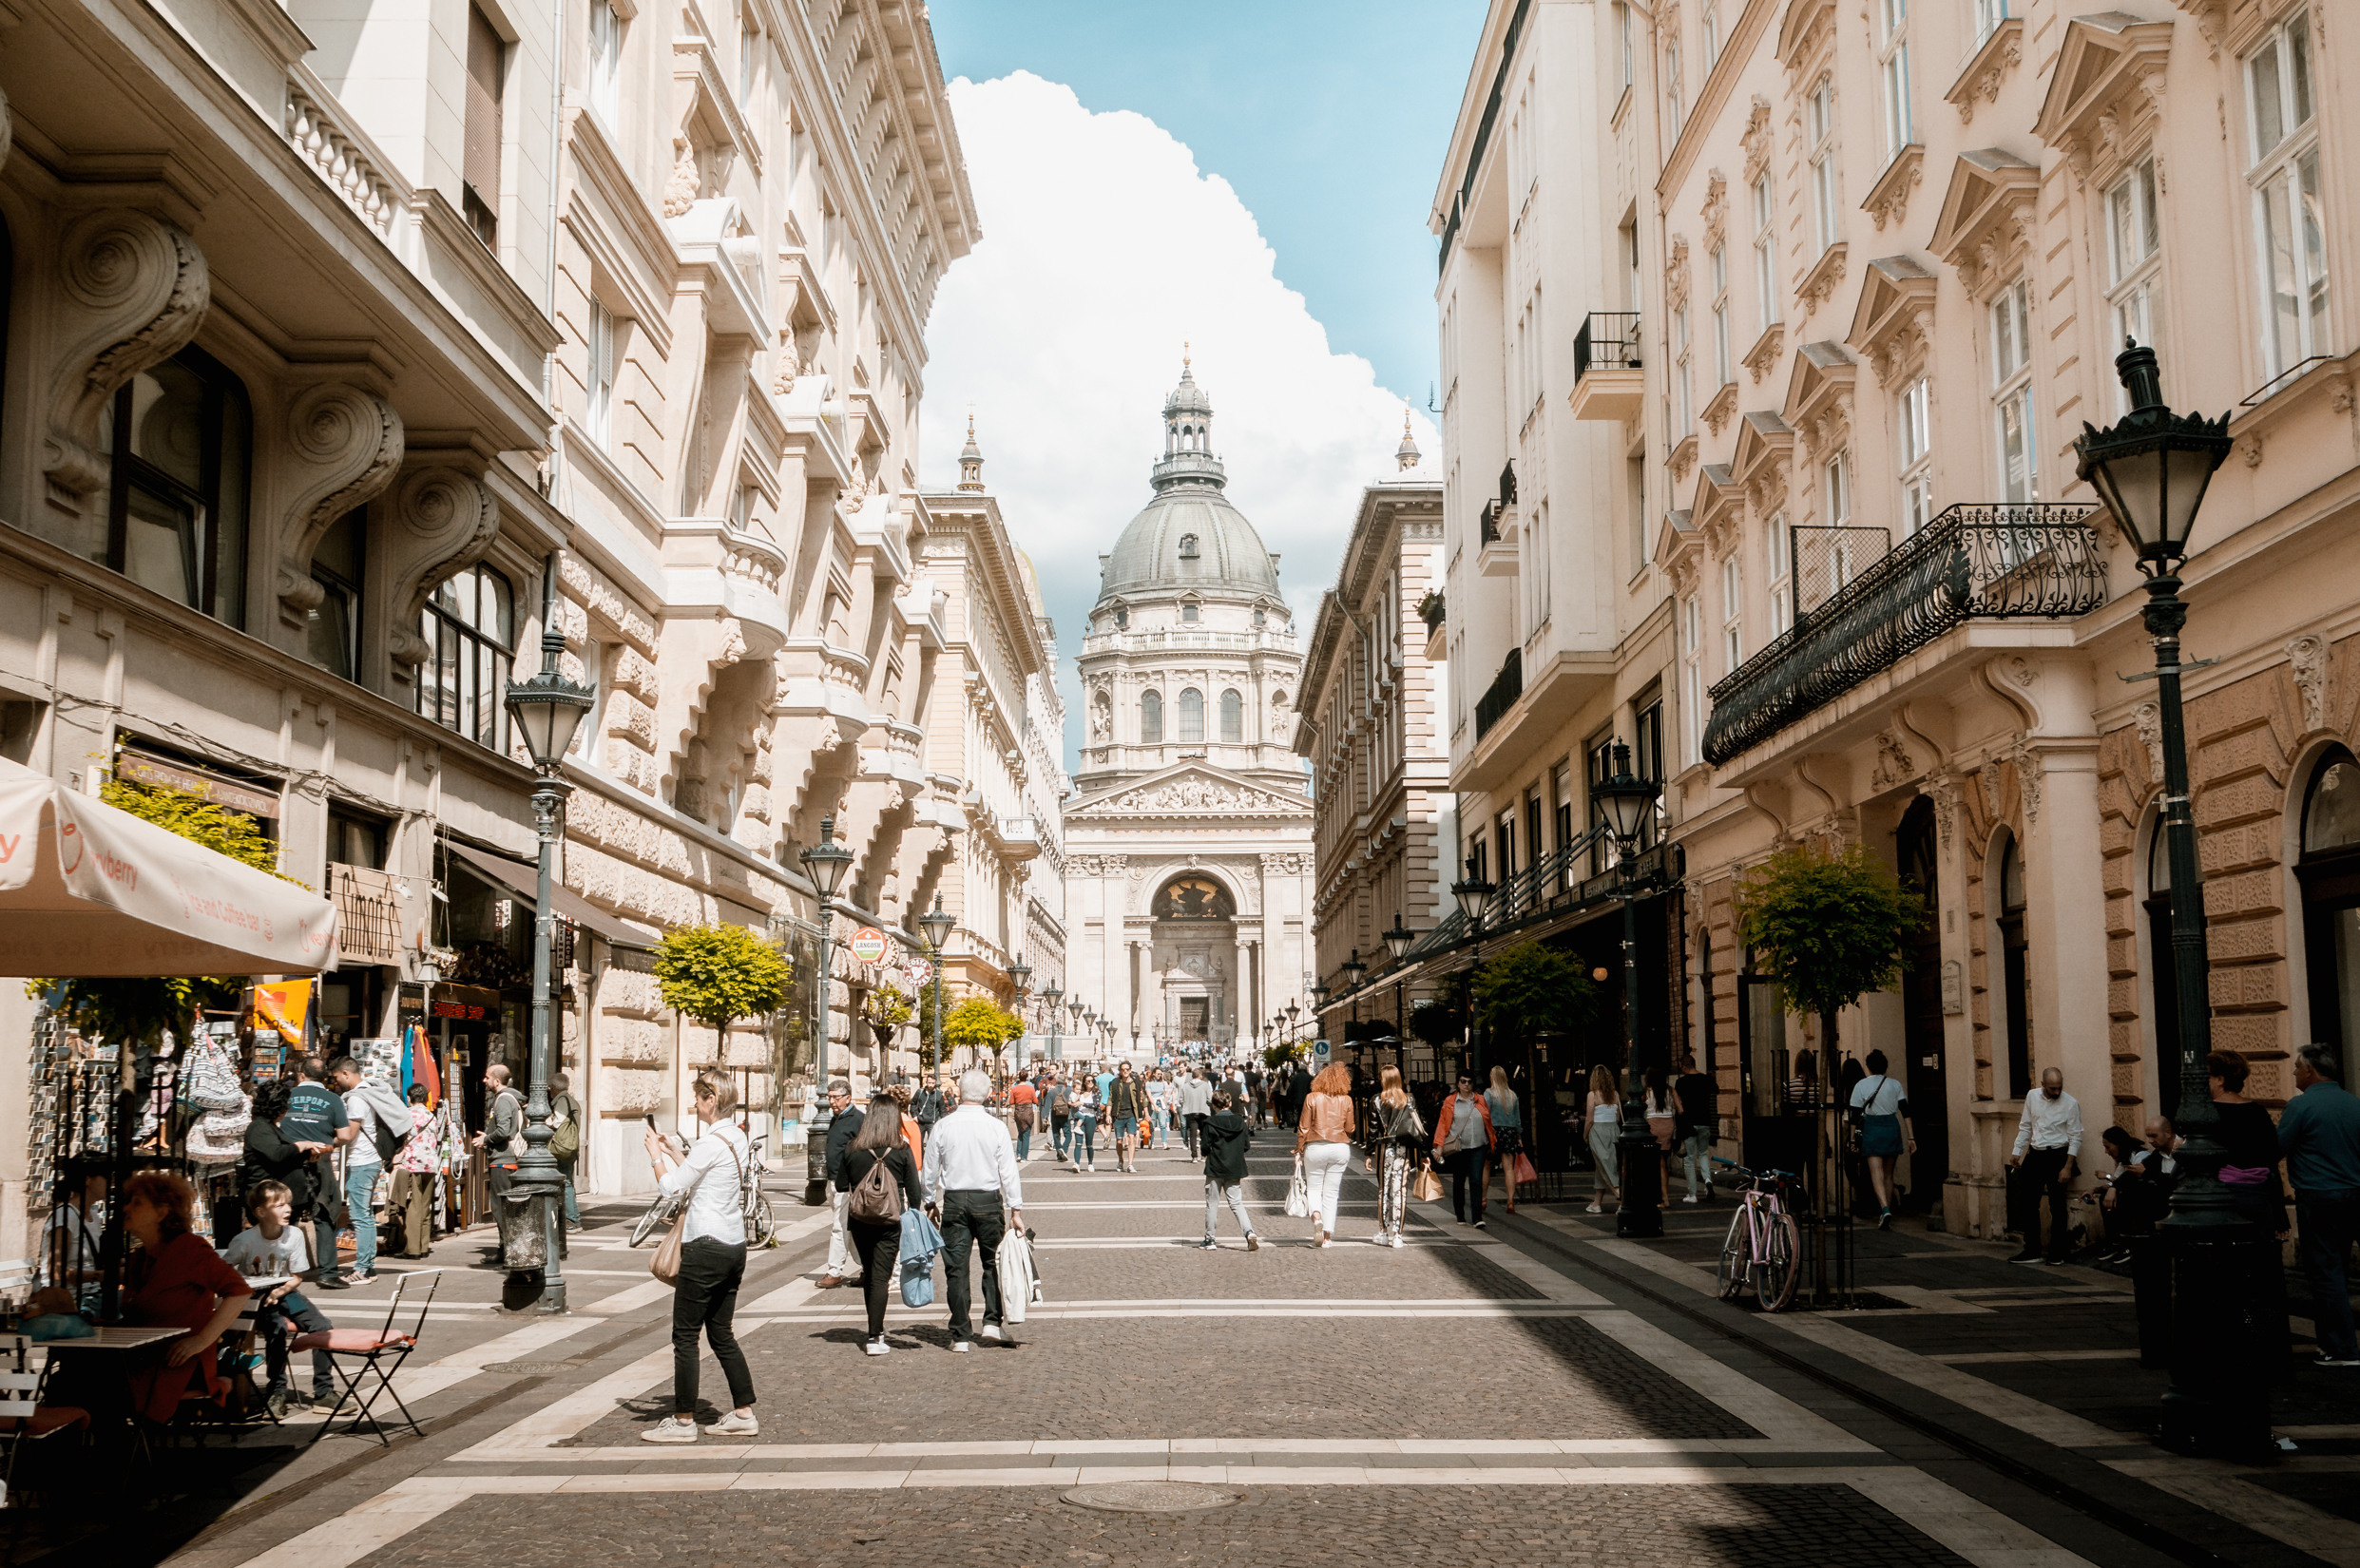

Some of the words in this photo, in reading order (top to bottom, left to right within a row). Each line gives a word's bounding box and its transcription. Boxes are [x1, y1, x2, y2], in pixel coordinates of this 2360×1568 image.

[340, 871, 396, 960] Simon's
[907, 959, 928, 968] COSTA
[906, 975, 931, 986] COFFEE
